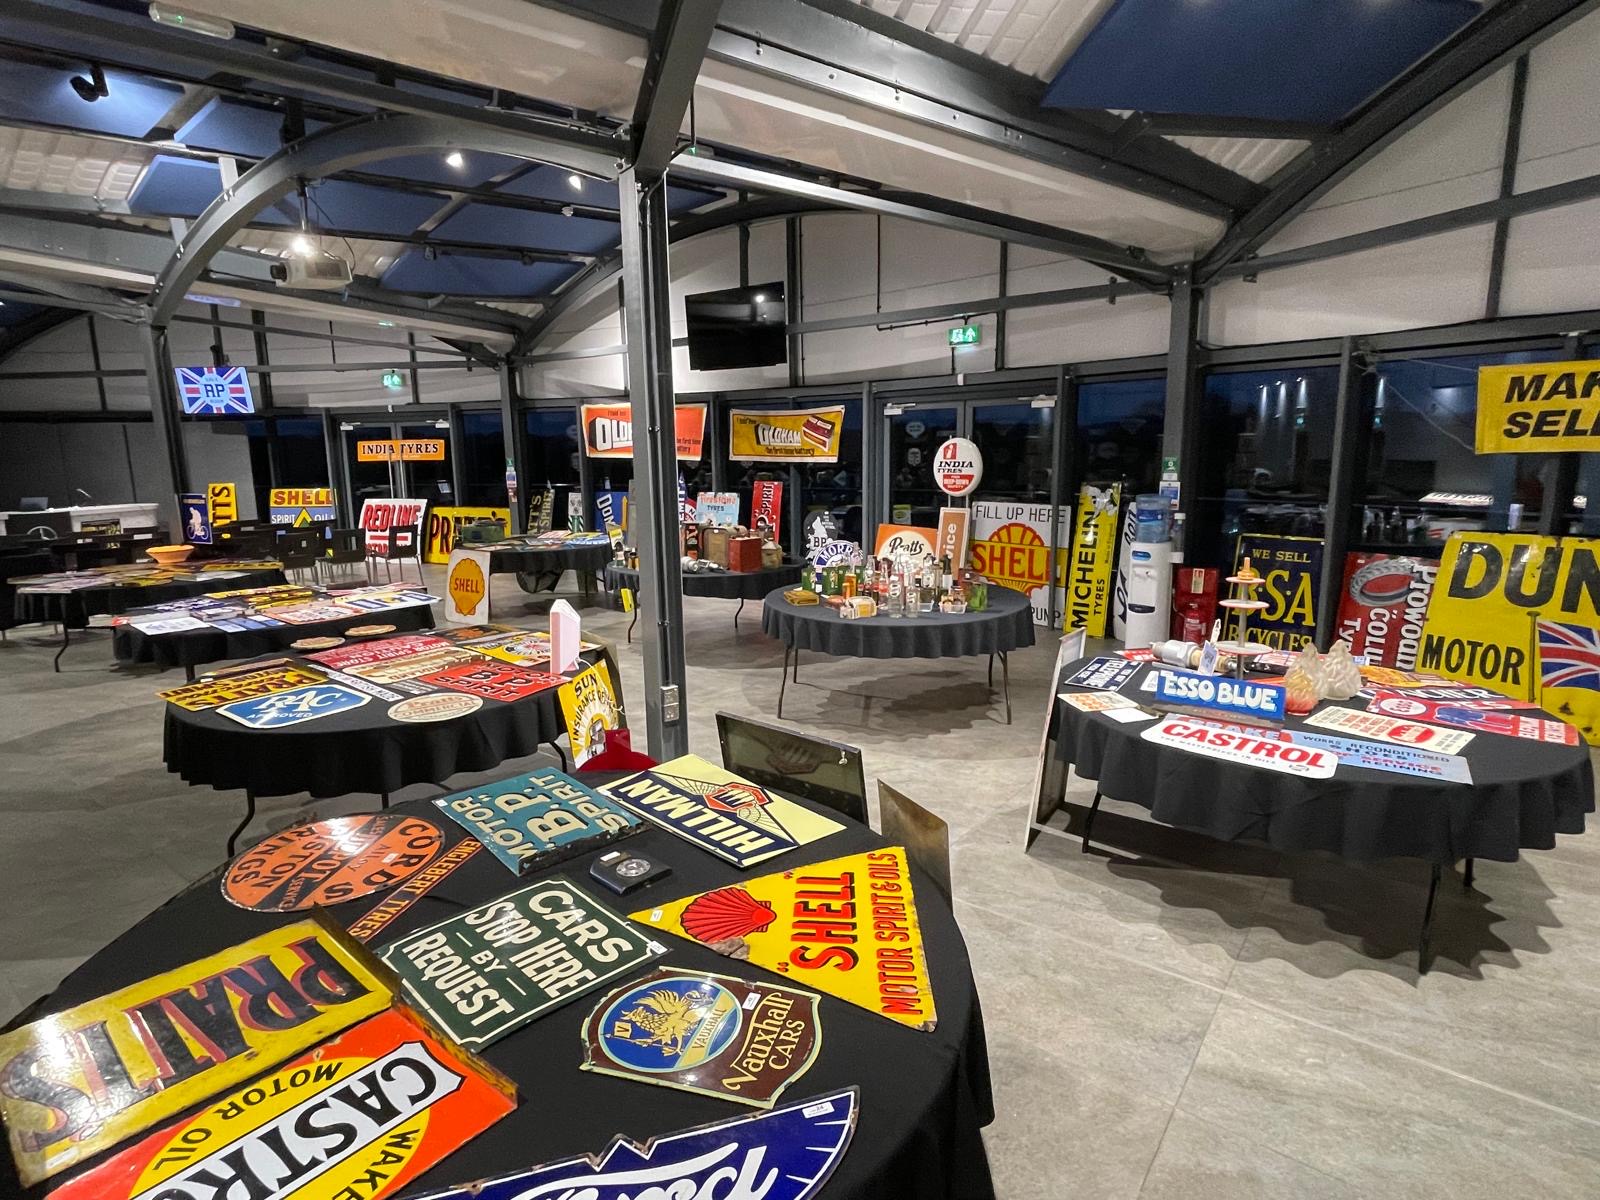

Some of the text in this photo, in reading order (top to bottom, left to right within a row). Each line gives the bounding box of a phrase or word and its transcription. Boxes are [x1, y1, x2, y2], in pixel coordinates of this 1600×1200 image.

[362, 443, 439, 455] INDIA TYRES
[757, 423, 801, 447] OLDHAM
[273, 490, 332, 506] SHELL
[707, 503, 725, 512] TYRES
[761, 482, 775, 516] SPIRIT
[975, 504, 1002, 520] FILL
[1006, 506, 1024, 521] UP
[271, 514, 296, 525] SPIRIT
[362, 504, 422, 533] REDLINE
[813, 536, 827, 548] BP
[889, 536, 925, 556] Pratts
[1252, 549, 1312, 564] WE SELL
[454, 577, 481, 594] SHELL
[1070, 510, 1101, 629] MICHELIN
[1448, 541, 1600, 614] DUN
[1093, 578, 1106, 617] TYRES
[1228, 623, 1313, 652] BCYCLES
[1420, 634, 1526, 686] MOTOR
[253, 690, 342, 714] RAC
[434, 675, 520, 698] SPIRIT
[574, 672, 598, 697] SUN
[1163, 672, 1215, 702] ESSO
[1216, 682, 1278, 713] BLUE
[393, 701, 477, 718] COMMERCIAL
[572, 690, 597, 741] INSURANCE
[1161, 723, 1326, 769] CASTROL
[1303, 735, 1450, 763] WORKS RECONDITIONED
[1360, 755, 1442, 771] SERVICE
[1361, 760, 1444, 776] RELINING
[527, 772, 620, 832] SPIRIT
[620, 778, 776, 854] HILLMAN
[451, 796, 528, 860] MOTOR
[232, 825, 318, 884] RINGS
[323, 823, 432, 901] CORDS
[866, 852, 900, 879] OILS
[347, 838, 484, 939] ENGLEBERT TYRES
[528, 889, 634, 963] CARS
[872, 889, 911, 946] SPIRIT
[465, 901, 598, 999] STOP HERE
[471, 950, 508, 972] BY
[402, 932, 516, 1026] REQUEST
[878, 949, 922, 1017] MOTOR
[1, 935, 374, 1155] PRATTS
[691, 1007, 728, 1050] VAUXHALL
[720, 991, 795, 1092] Vauxhall
[768, 1018, 806, 1071] CARS
[152, 1060, 343, 1172] MOTOR OIL
